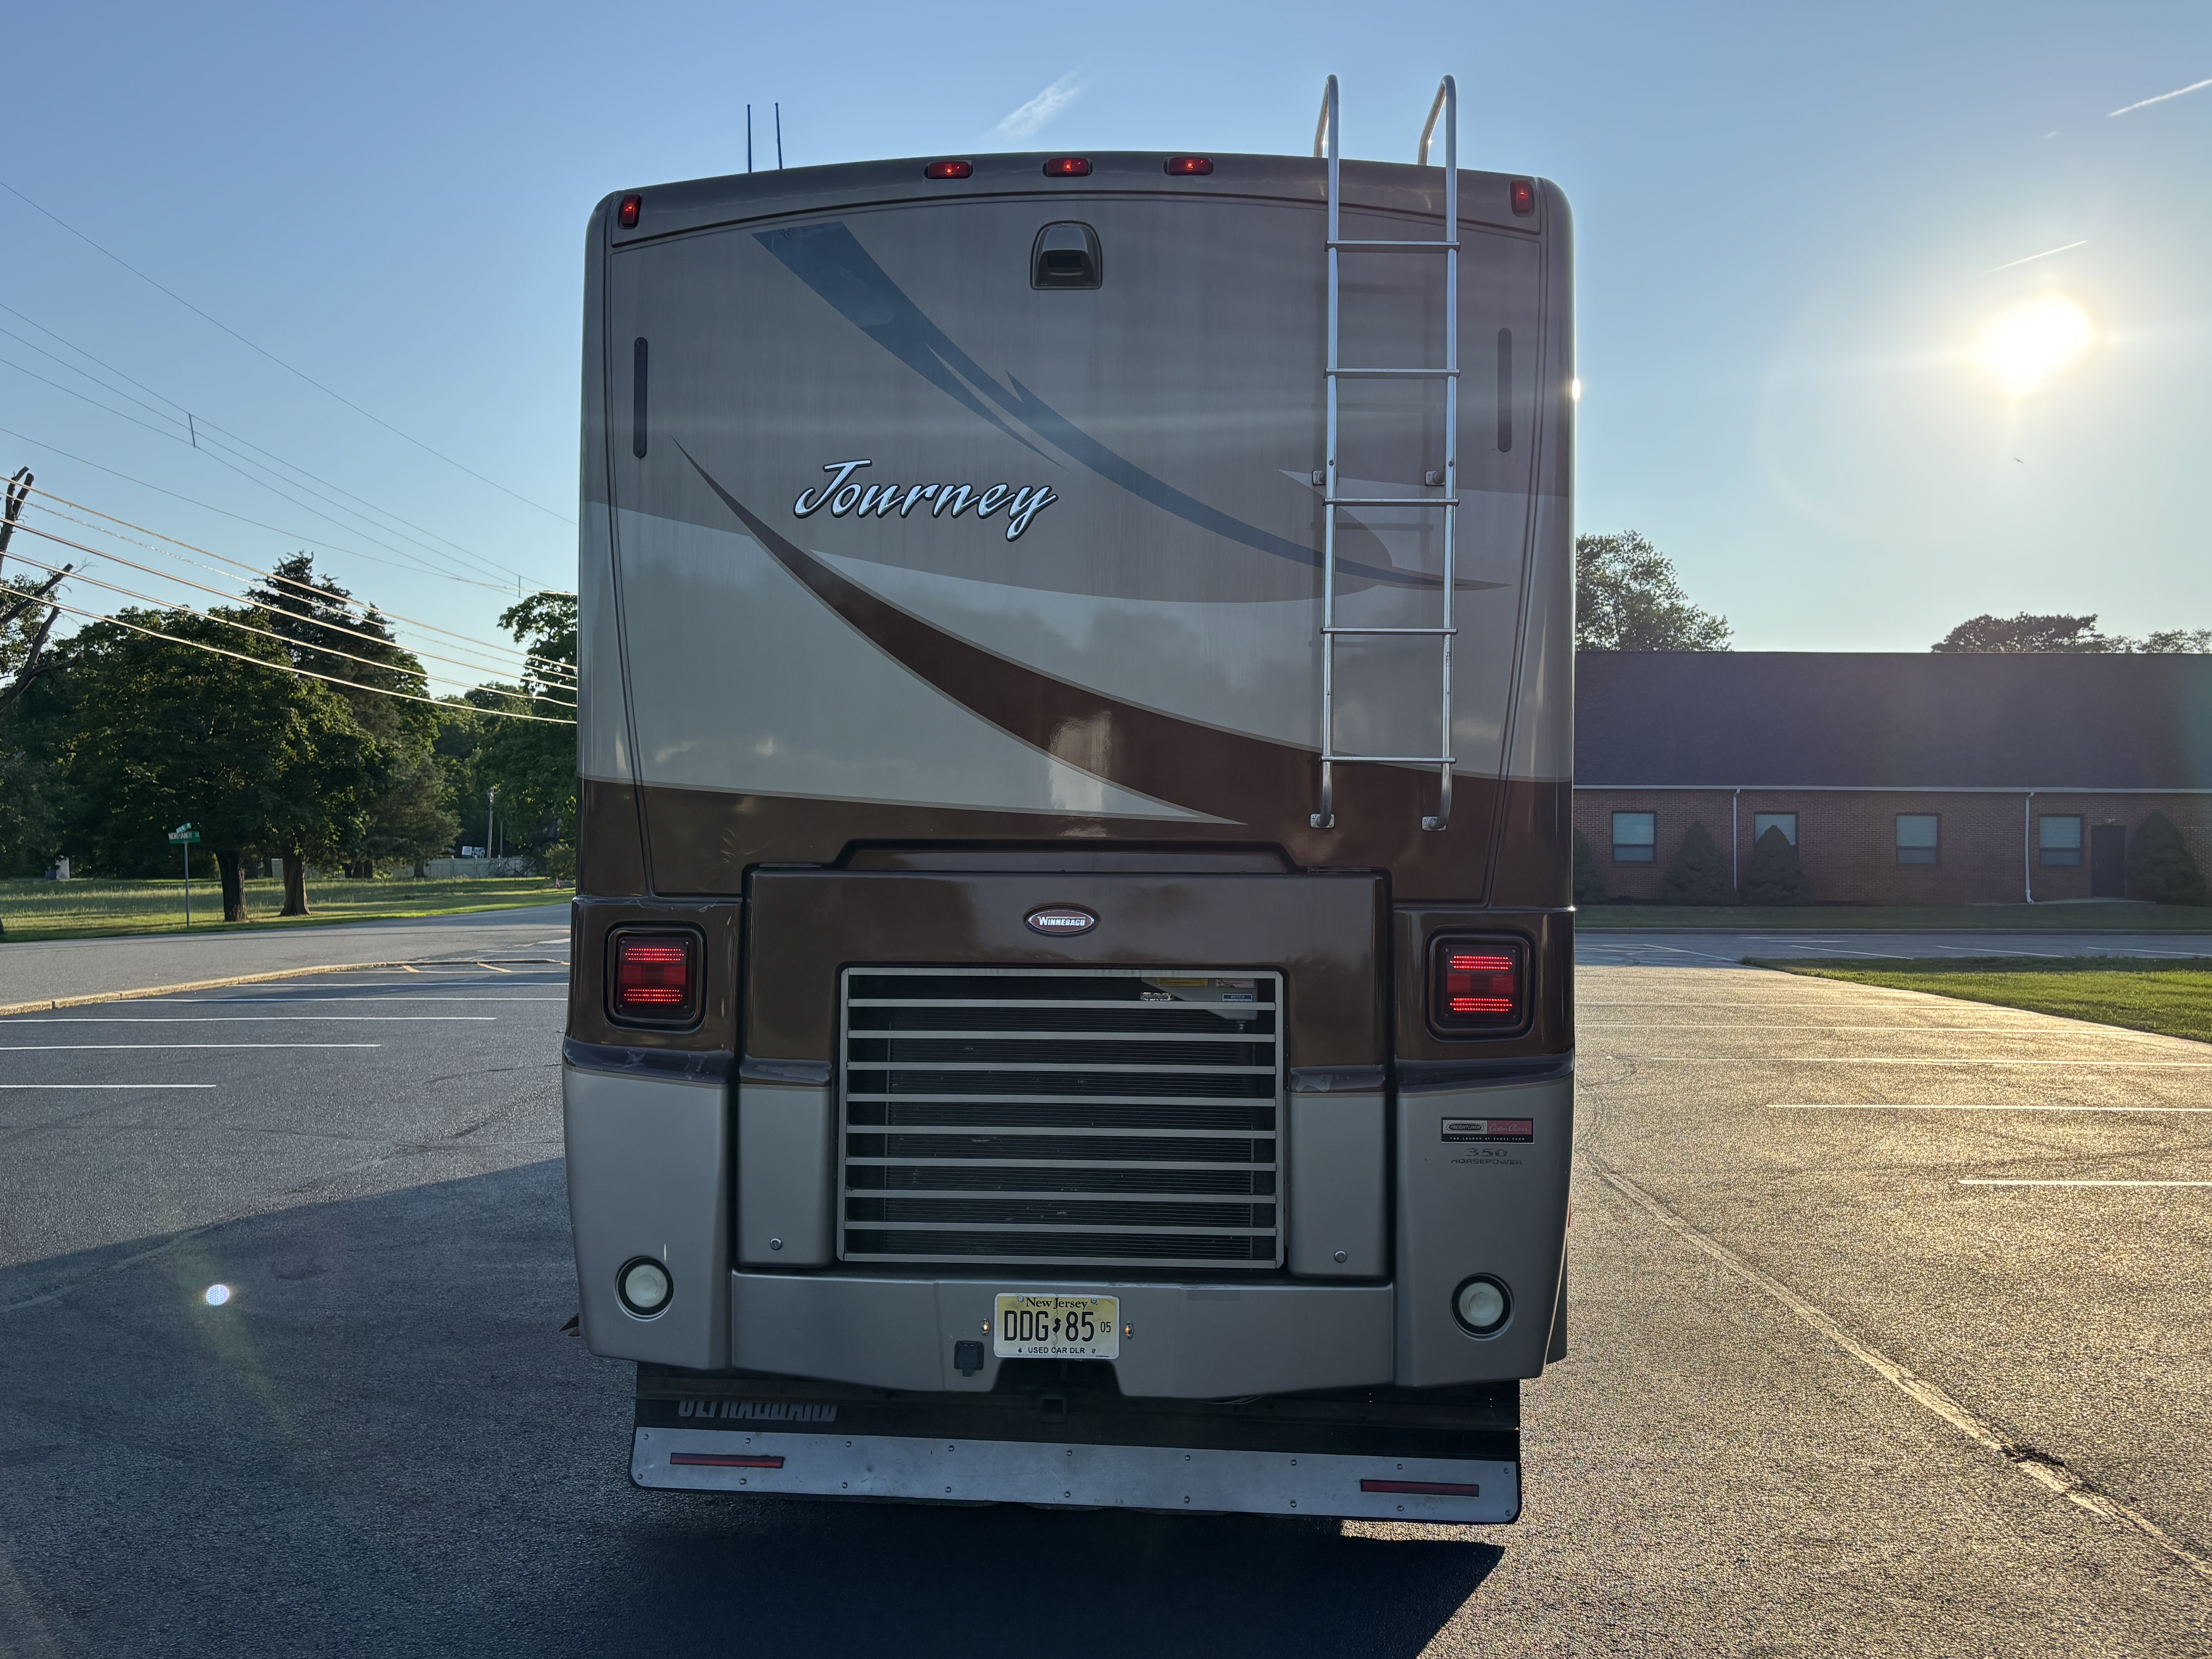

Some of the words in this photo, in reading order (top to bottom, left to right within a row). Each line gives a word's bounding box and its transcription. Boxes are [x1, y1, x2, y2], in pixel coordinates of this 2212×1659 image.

[793, 459, 1059, 542] Journey
[1037, 916, 1085, 926] WINNEBAGO
[1490, 1123, 1508, 1132] Custom
[1509, 1124, 1530, 1132] Chassis
[1466, 1147, 1508, 1157] 350
[1026, 1297, 1052, 1307] New
[1053, 1298, 1088, 1310] Jersey
[1004, 1310, 1049, 1341] DDG
[1065, 1311, 1094, 1342] 85
[1100, 1321, 1111, 1333] 05
